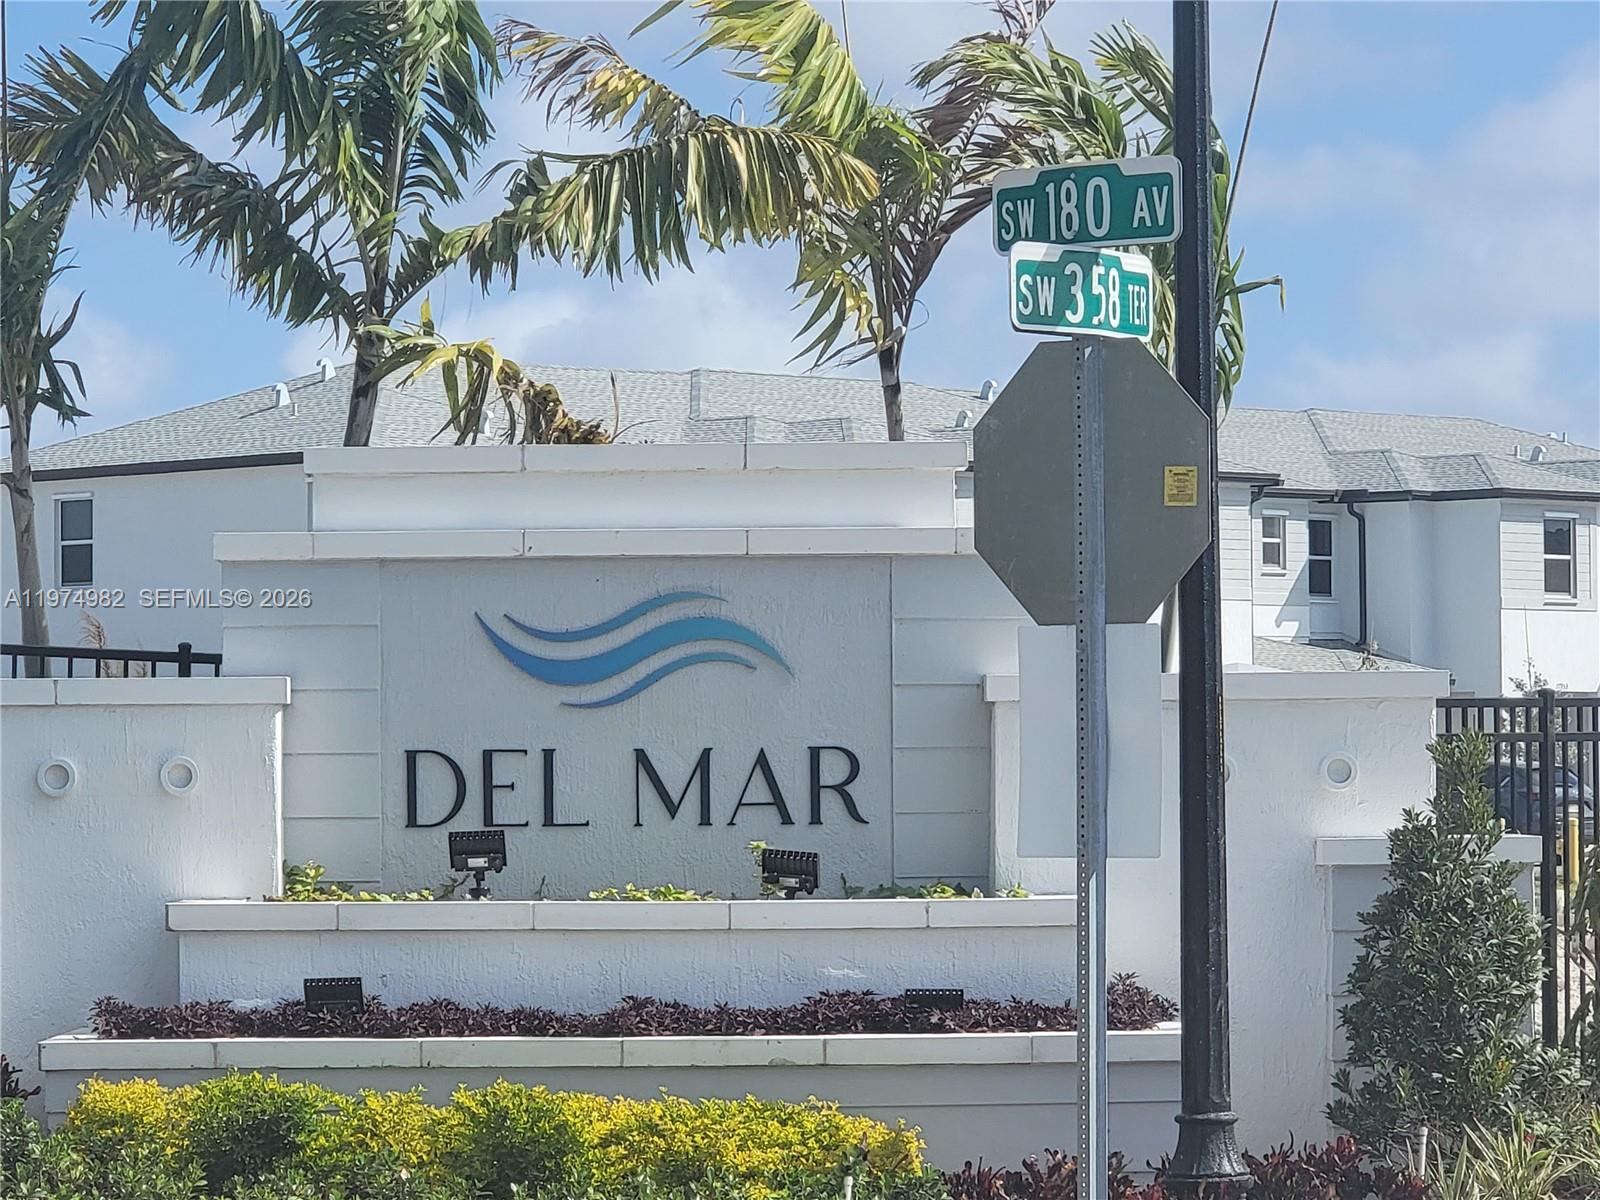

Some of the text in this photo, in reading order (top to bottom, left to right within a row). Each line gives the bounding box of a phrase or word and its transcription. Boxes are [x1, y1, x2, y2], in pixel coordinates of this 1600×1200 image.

[1001, 176, 1169, 241] SW 180 AV
[1018, 262, 1147, 328] SW 358 TER
[404, 745, 870, 829] DEL MAR
